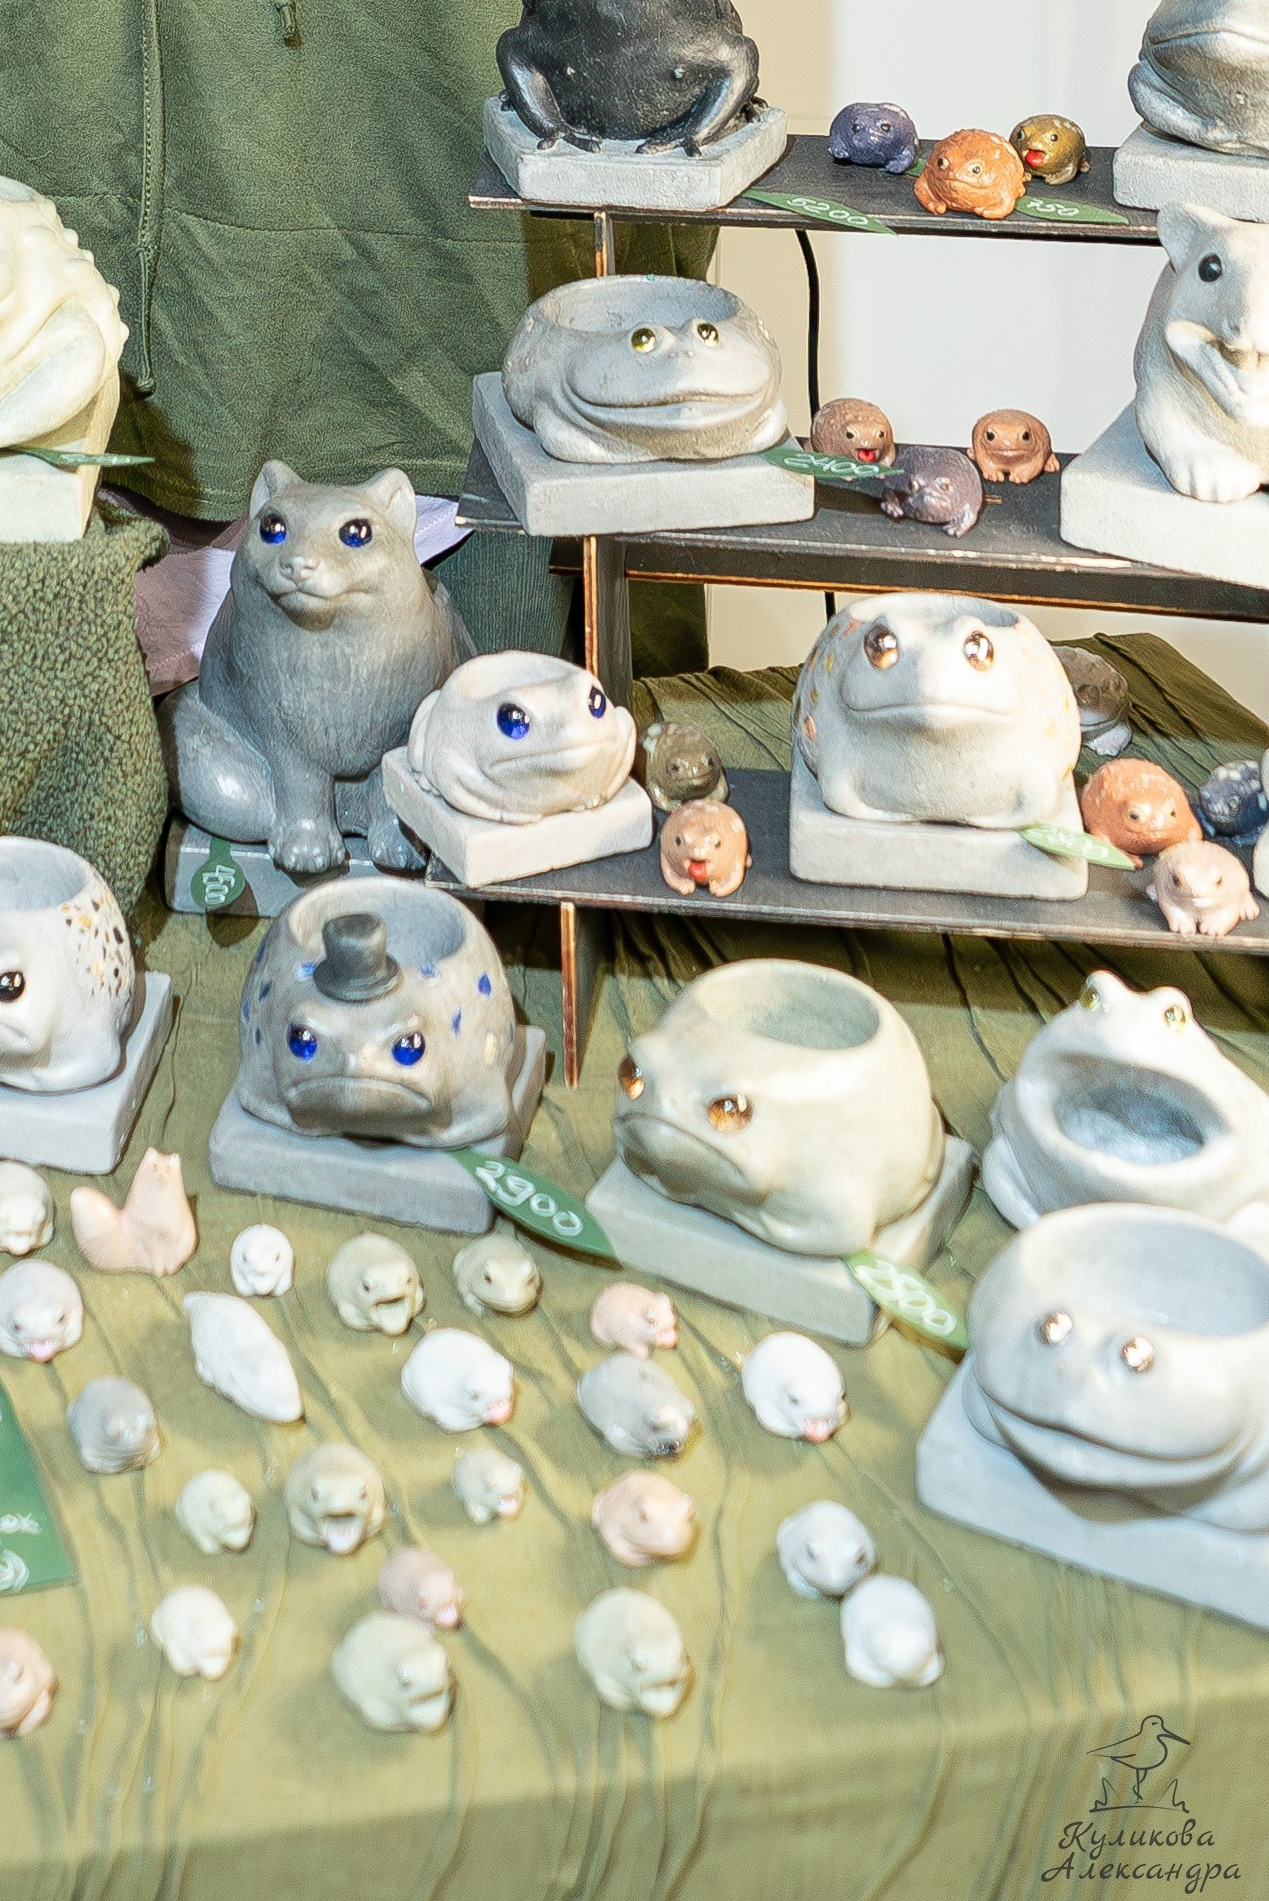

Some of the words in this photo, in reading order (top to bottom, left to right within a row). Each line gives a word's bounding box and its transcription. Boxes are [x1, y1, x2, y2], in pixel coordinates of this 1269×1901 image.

[787, 197, 869, 226] 5200
[1026, 198, 1080, 217] 750
[784, 453, 880, 476] 2400
[475, 1161, 584, 1237] 2900
